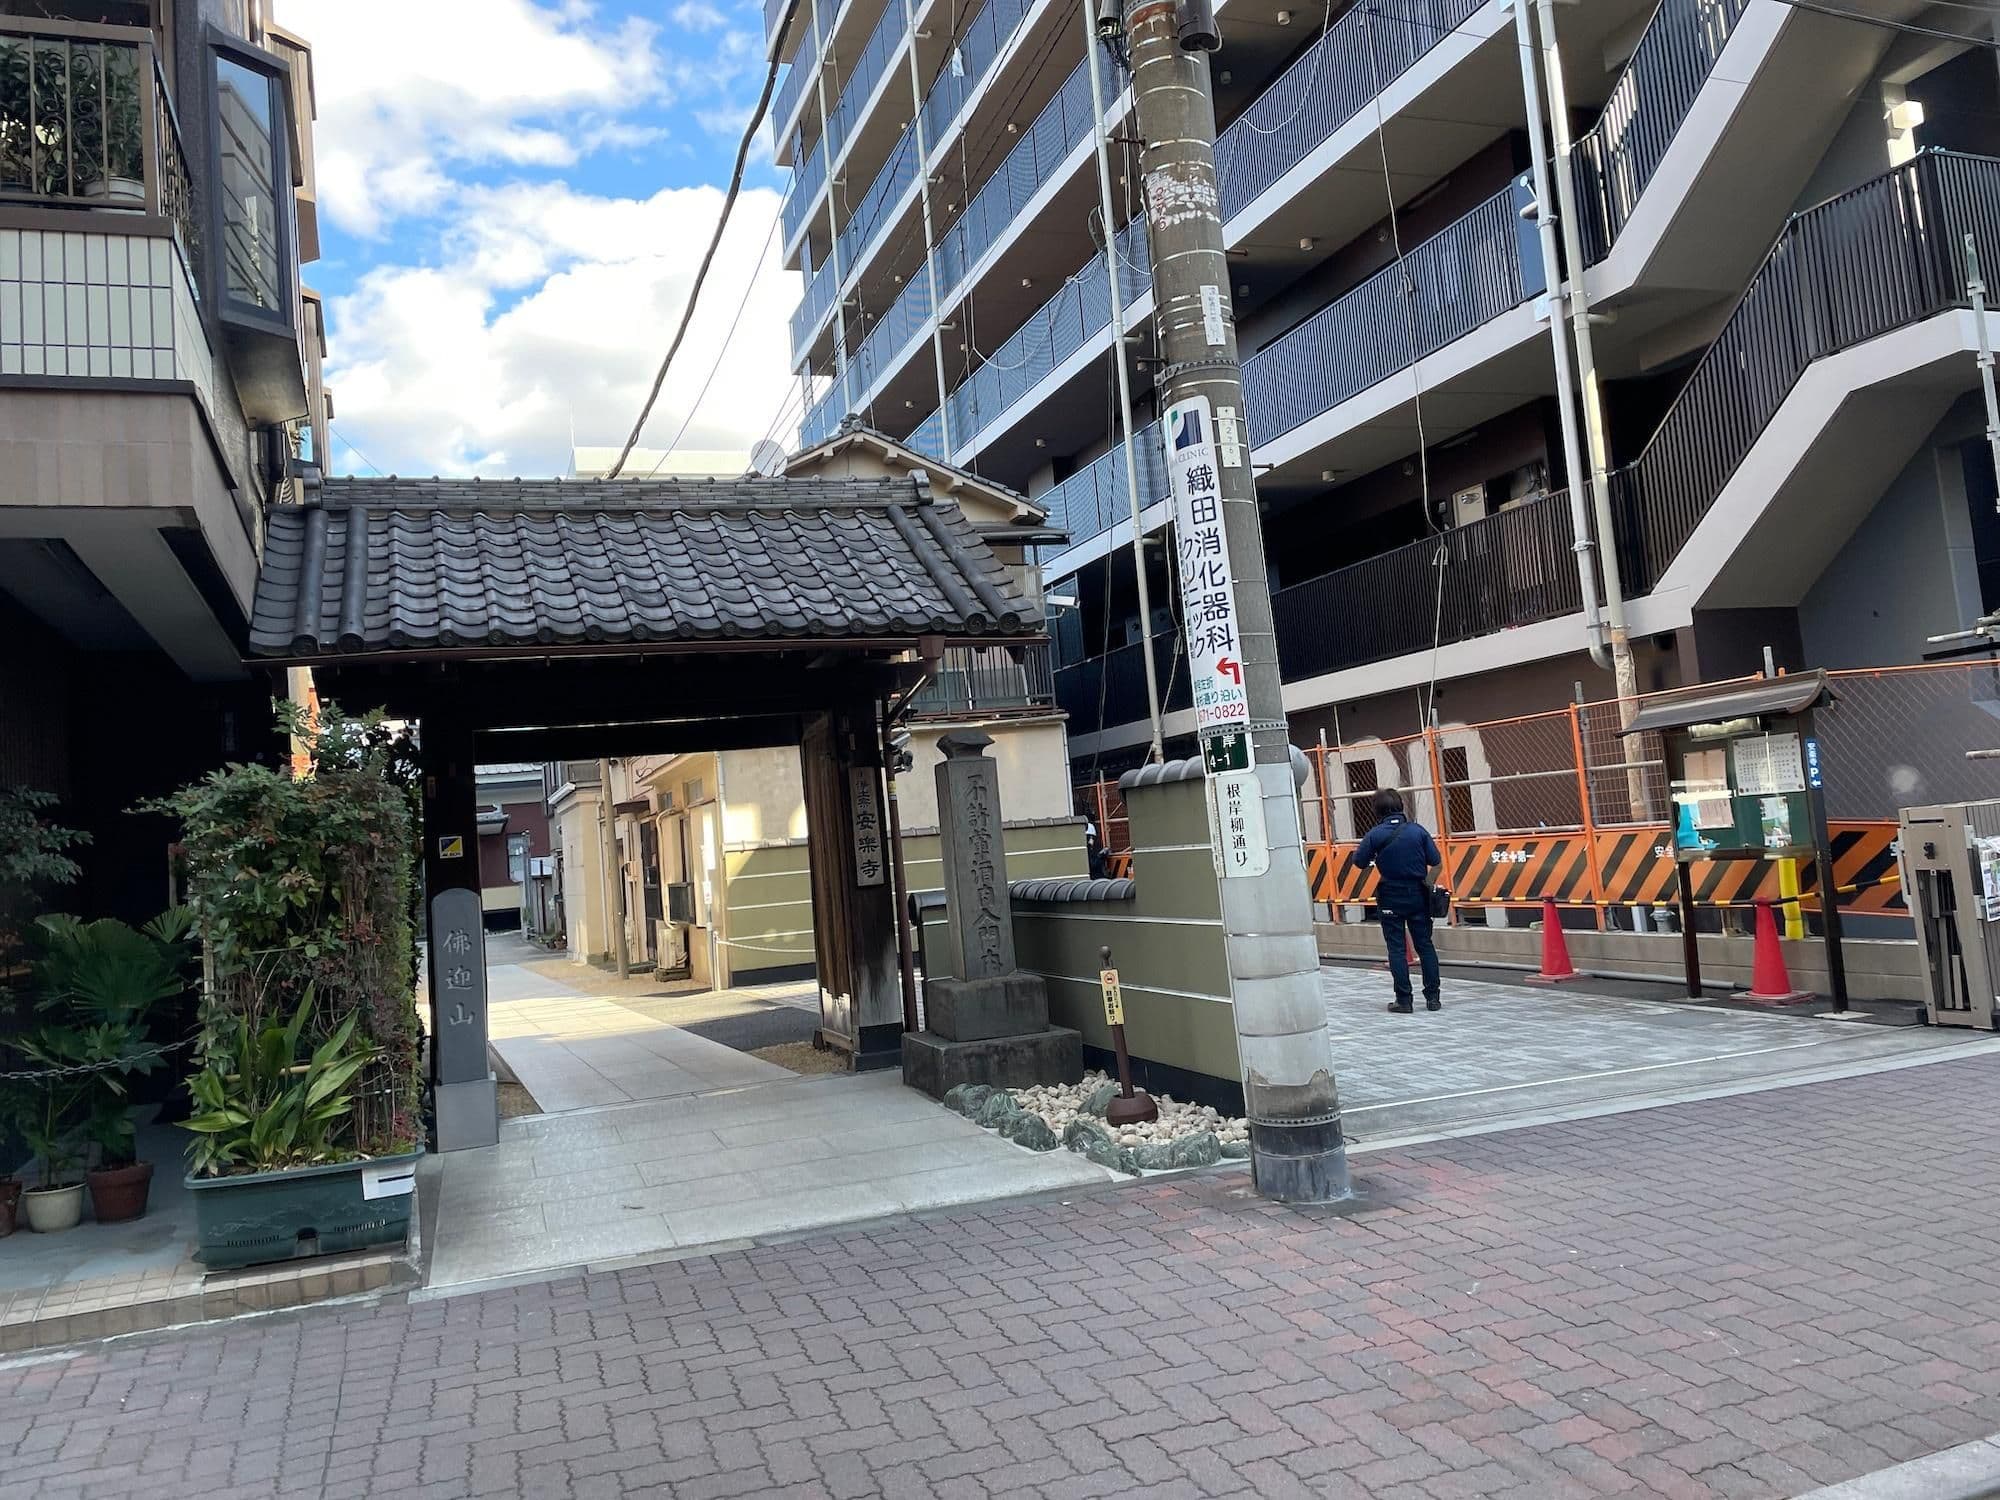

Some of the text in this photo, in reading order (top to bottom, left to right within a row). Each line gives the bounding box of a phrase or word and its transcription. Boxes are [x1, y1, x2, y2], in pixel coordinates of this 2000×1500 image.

[1183, 536, 1206, 658] クリニック
[1186, 463, 1233, 652] 織田消化器科
[1210, 752, 1231, 768] 4-1
[1226, 783, 1248, 867] 根岸柳通り
[443, 928, 475, 1025] 佛迎山
